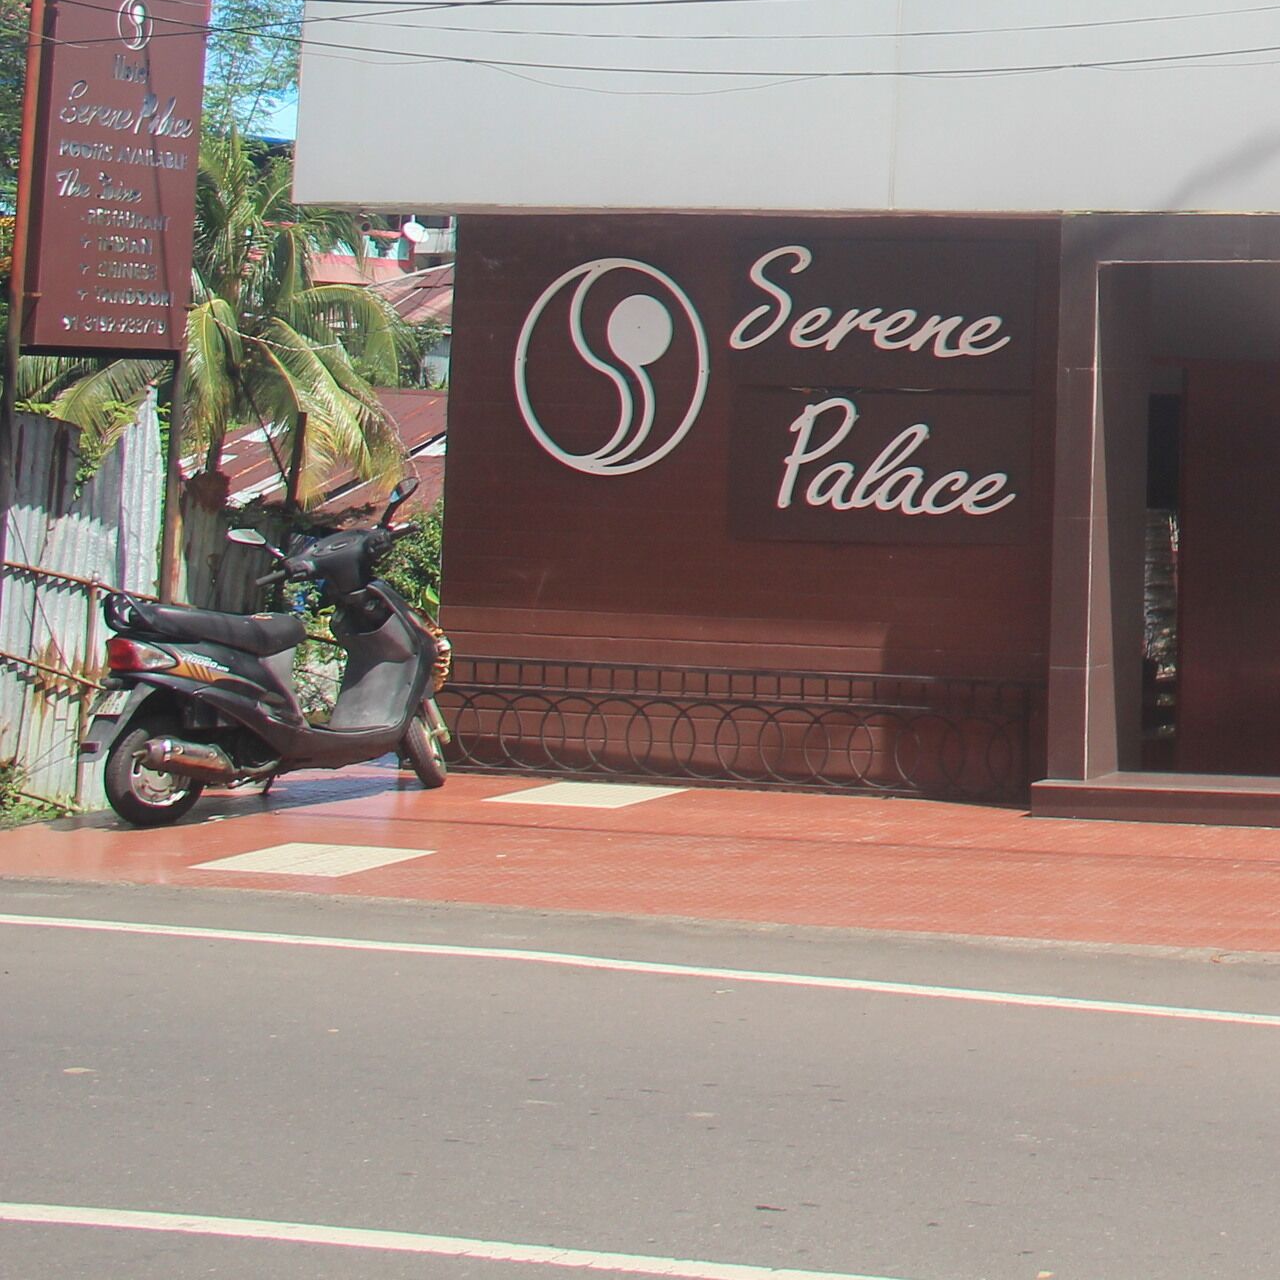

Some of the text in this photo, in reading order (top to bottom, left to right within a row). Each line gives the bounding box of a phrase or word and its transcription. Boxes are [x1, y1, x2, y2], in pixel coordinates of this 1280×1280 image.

[59, 79, 193, 138] Serene Palace
[56, 168, 91, 197] The
[59, 140, 188, 170] ROOMS AVAILABLE
[729, 244, 1011, 358] Serene
[777, 397, 1016, 515] Palace
